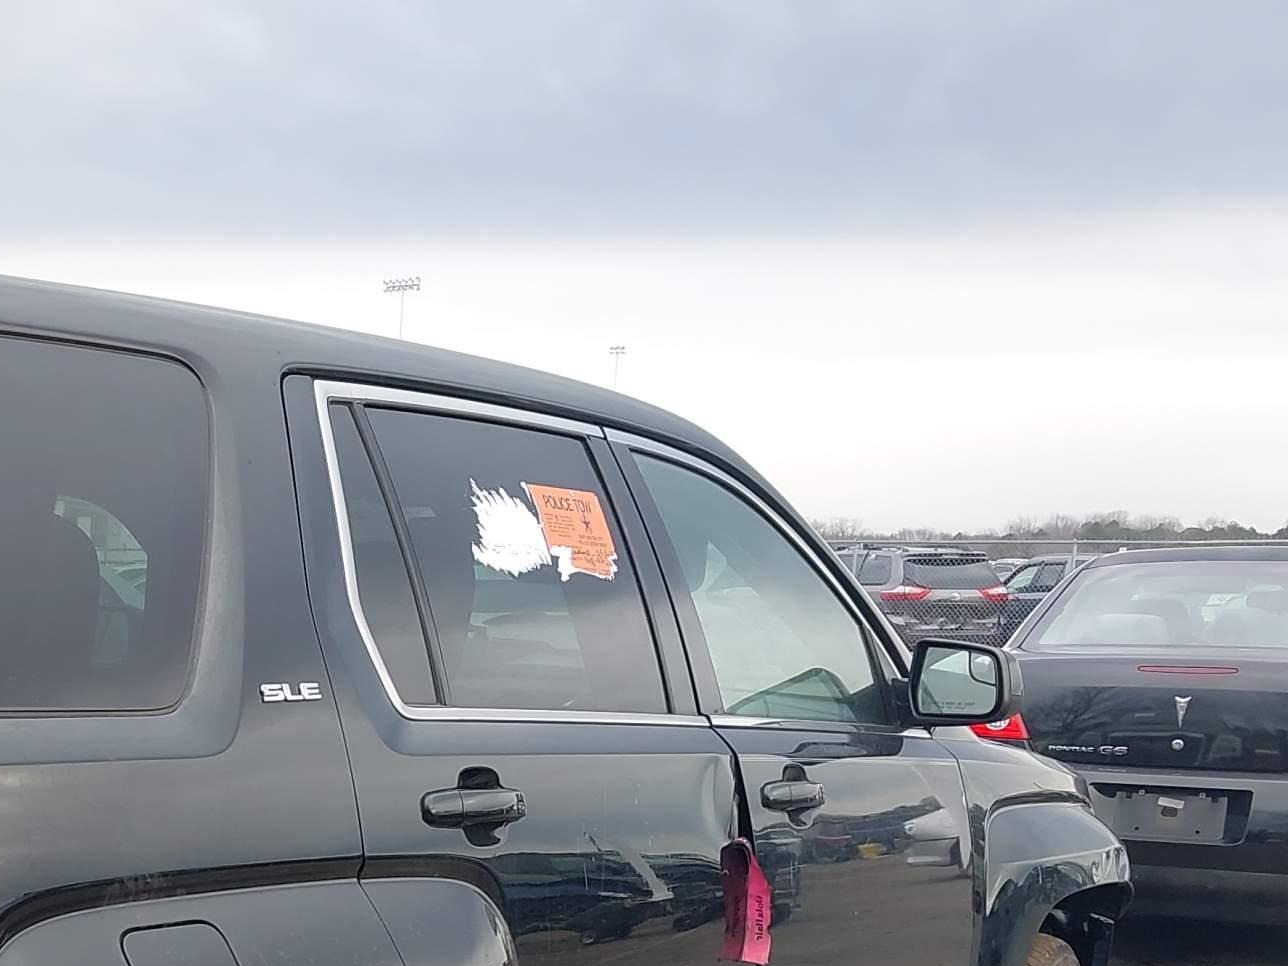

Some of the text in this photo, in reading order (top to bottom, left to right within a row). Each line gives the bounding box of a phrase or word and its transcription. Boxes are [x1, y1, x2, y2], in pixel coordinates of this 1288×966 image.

[542, 494, 592, 515] POLICE TOW
[260, 682, 322, 703] SLE
[1048, 745, 1095, 753] PONTIAC
